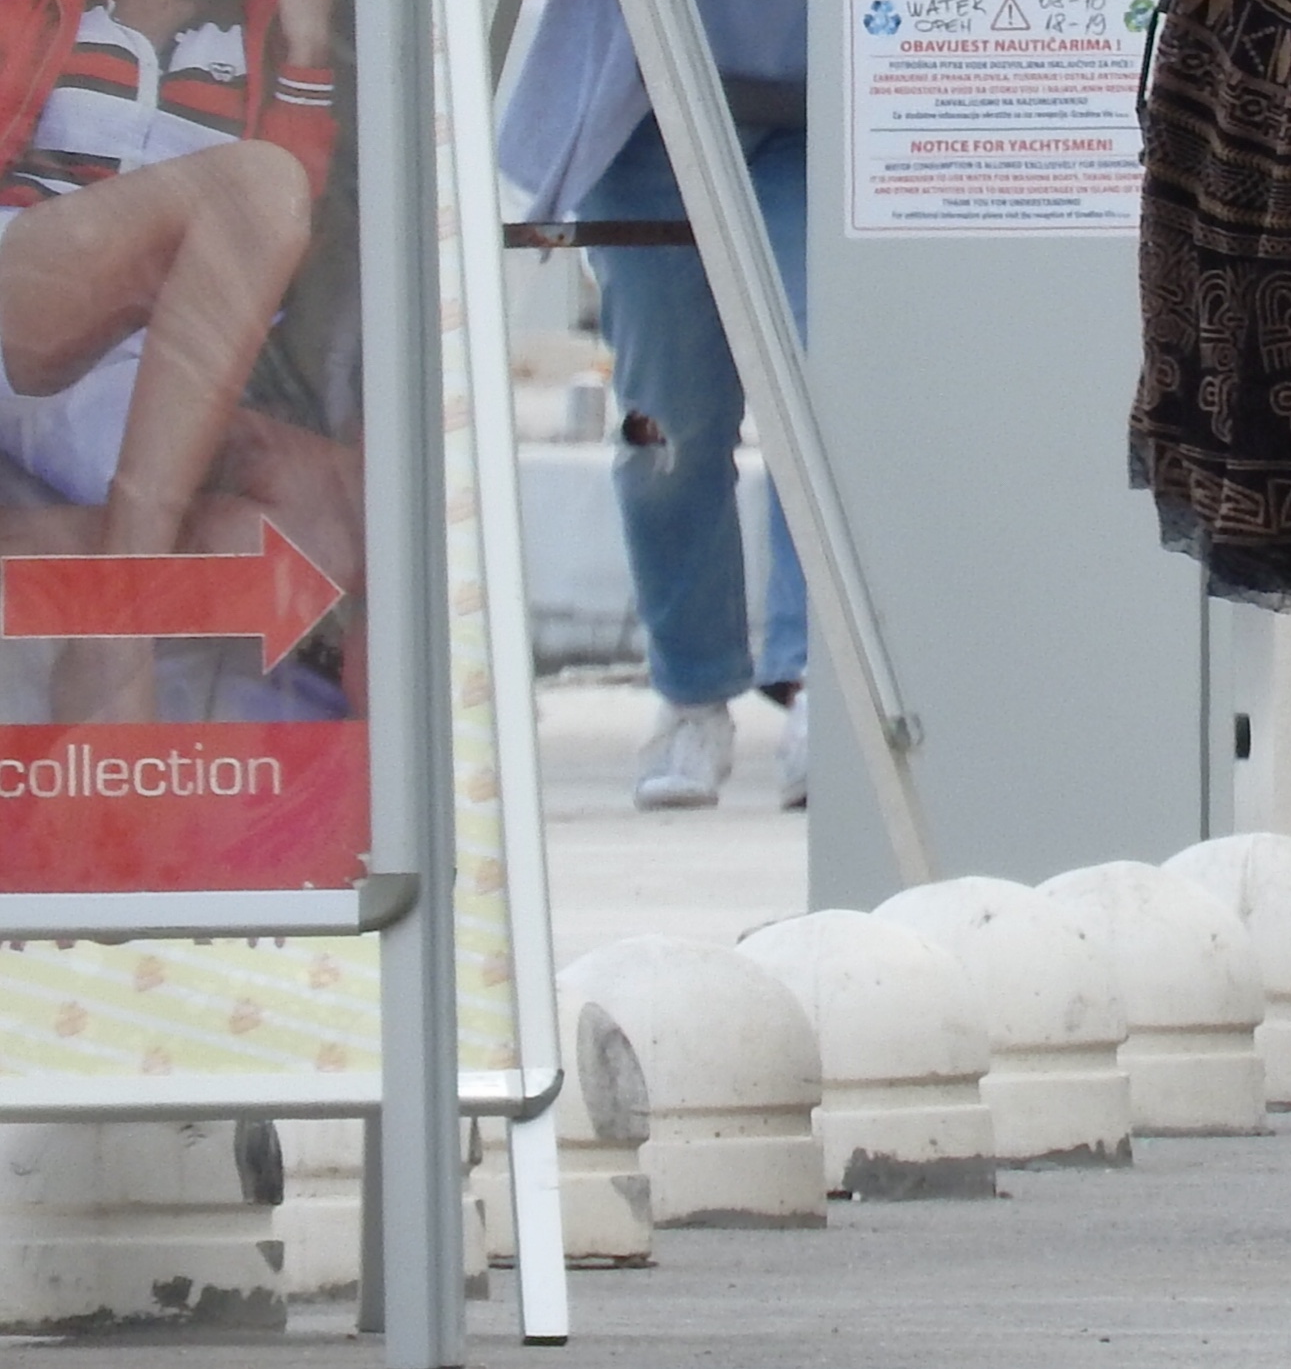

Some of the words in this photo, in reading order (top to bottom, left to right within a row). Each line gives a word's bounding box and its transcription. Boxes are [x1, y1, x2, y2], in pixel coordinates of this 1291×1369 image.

[900, 40, 990, 53] OBAVIJEST
[910, 139, 970, 153] NOTICE
[973, 139, 1006, 152] FOR
[1008, 138, 1114, 152] YACHTSMEN!
[0, 741, 283, 799] collection
